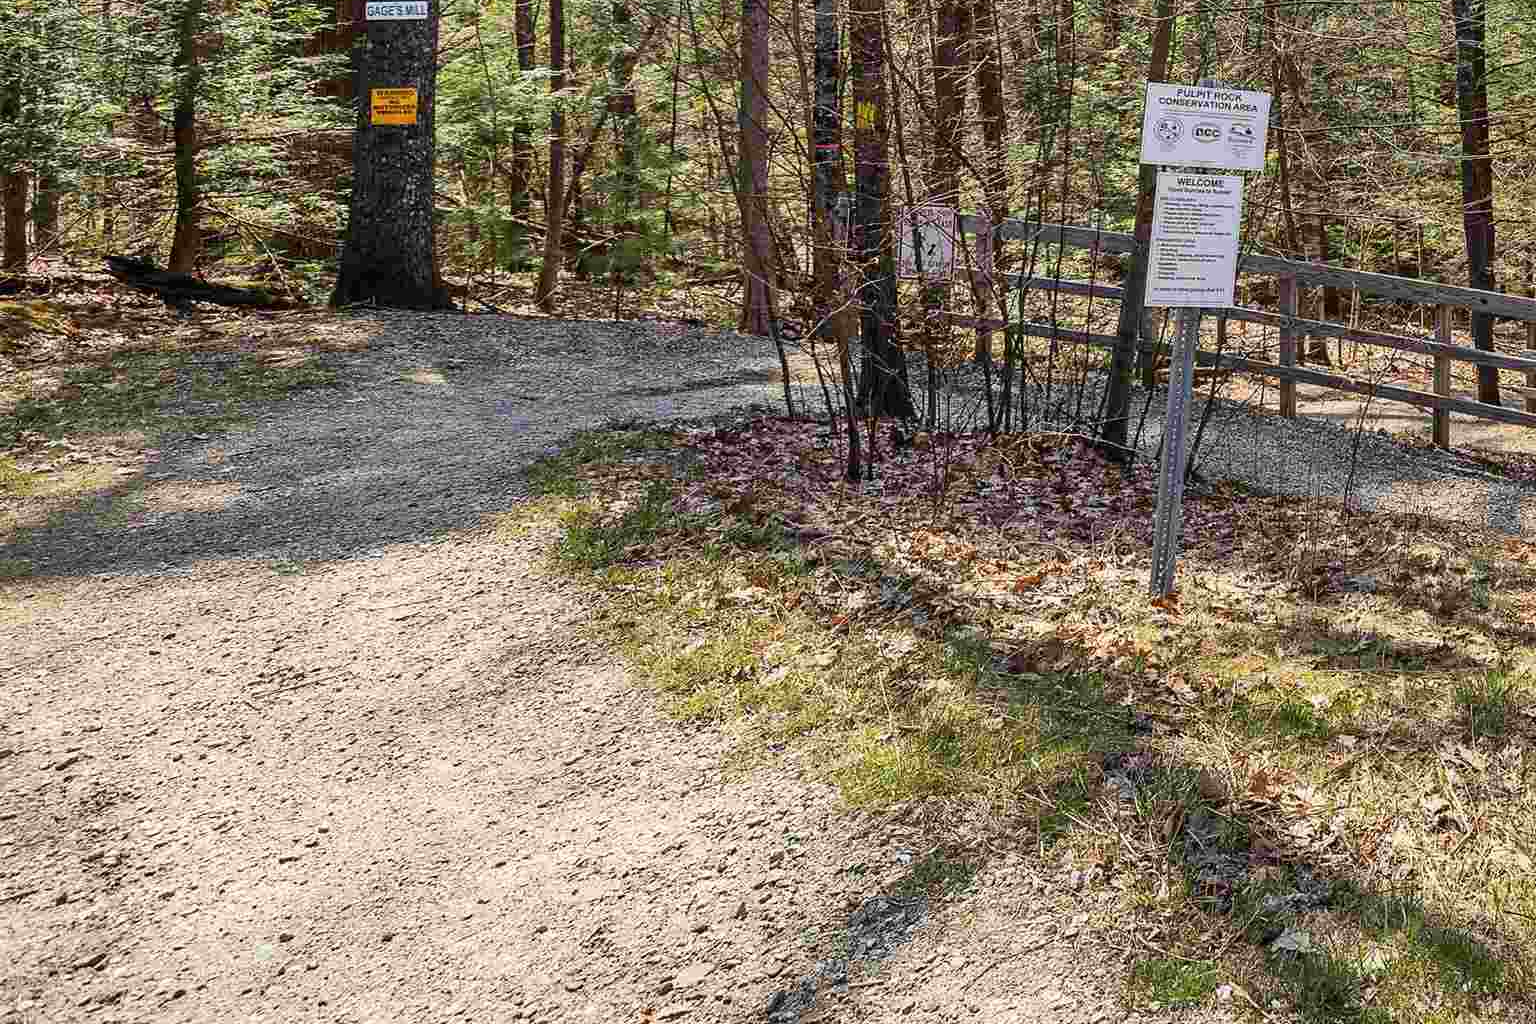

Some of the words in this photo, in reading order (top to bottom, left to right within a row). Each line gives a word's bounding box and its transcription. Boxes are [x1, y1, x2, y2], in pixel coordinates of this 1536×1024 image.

[367, 5, 402, 17] GAGE'S
[405, 5, 427, 16] MILL
[1176, 88, 1211, 99] PULPIT
[1214, 91, 1243, 102] ROCK
[1158, 97, 1231, 111] CONSERVATION
[1232, 103, 1258, 113] AREA
[1176, 176, 1225, 188] WELCOME
